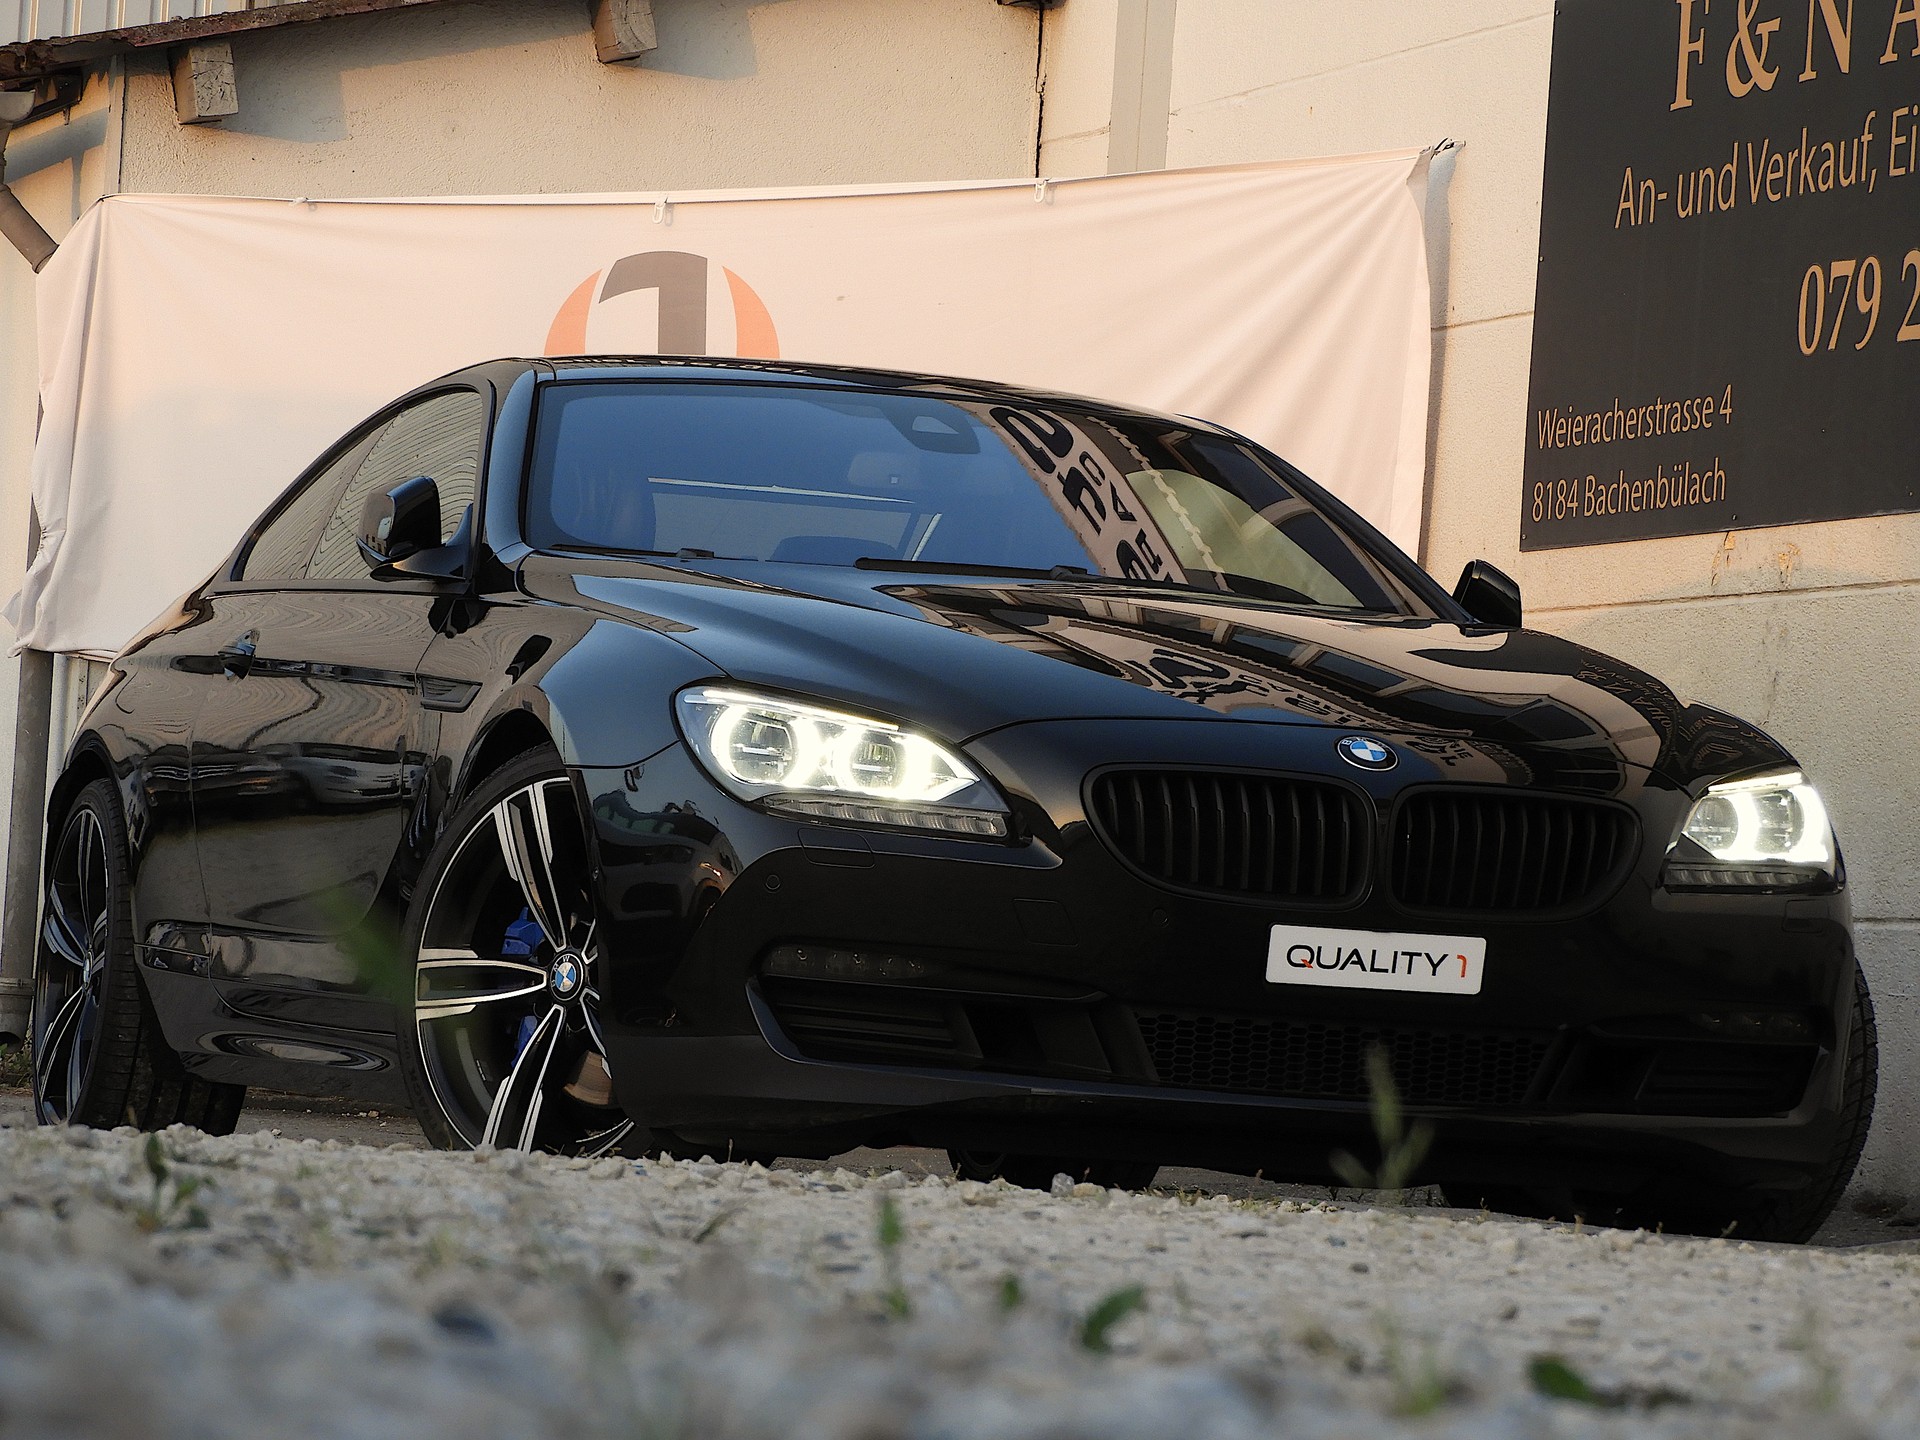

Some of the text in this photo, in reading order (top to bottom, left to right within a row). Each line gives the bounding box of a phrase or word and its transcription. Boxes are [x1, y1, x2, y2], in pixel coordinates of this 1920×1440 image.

[1614, 103, 1919, 229] An- und Verkauf, Ei
[1797, 248, 1920, 356] 079 2
[1537, 384, 1734, 449] Weieracherstrasse 4
[1531, 456, 1727, 522] 8184 Bachenbülach
[1286, 944, 1468, 978] QUALITY 1
